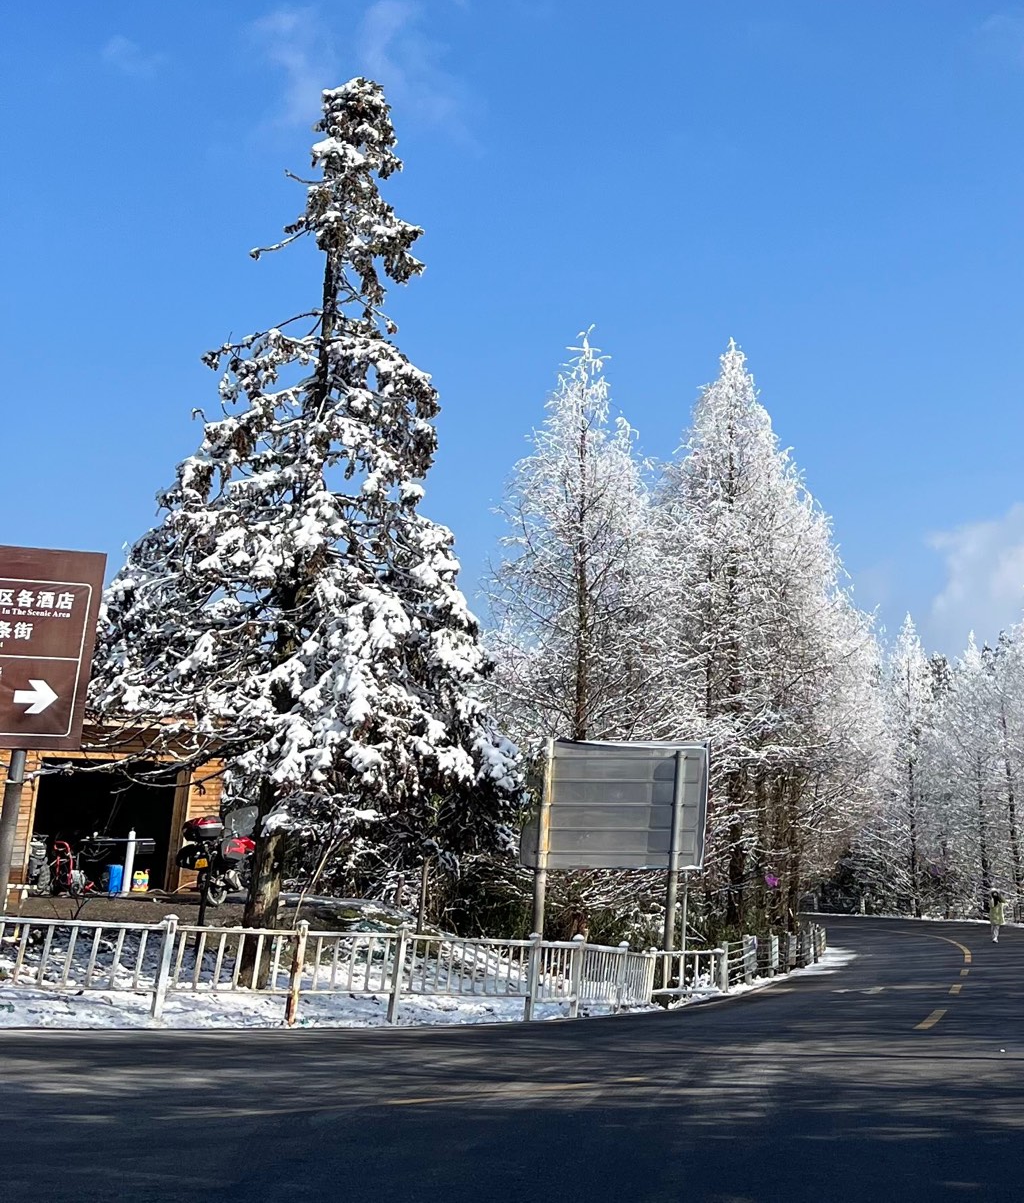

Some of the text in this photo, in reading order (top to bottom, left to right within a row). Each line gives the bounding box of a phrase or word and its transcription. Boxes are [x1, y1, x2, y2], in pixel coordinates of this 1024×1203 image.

[0, 588, 75, 610] 区各酒店
[2, 607, 71, 618] In The Scenic Area
